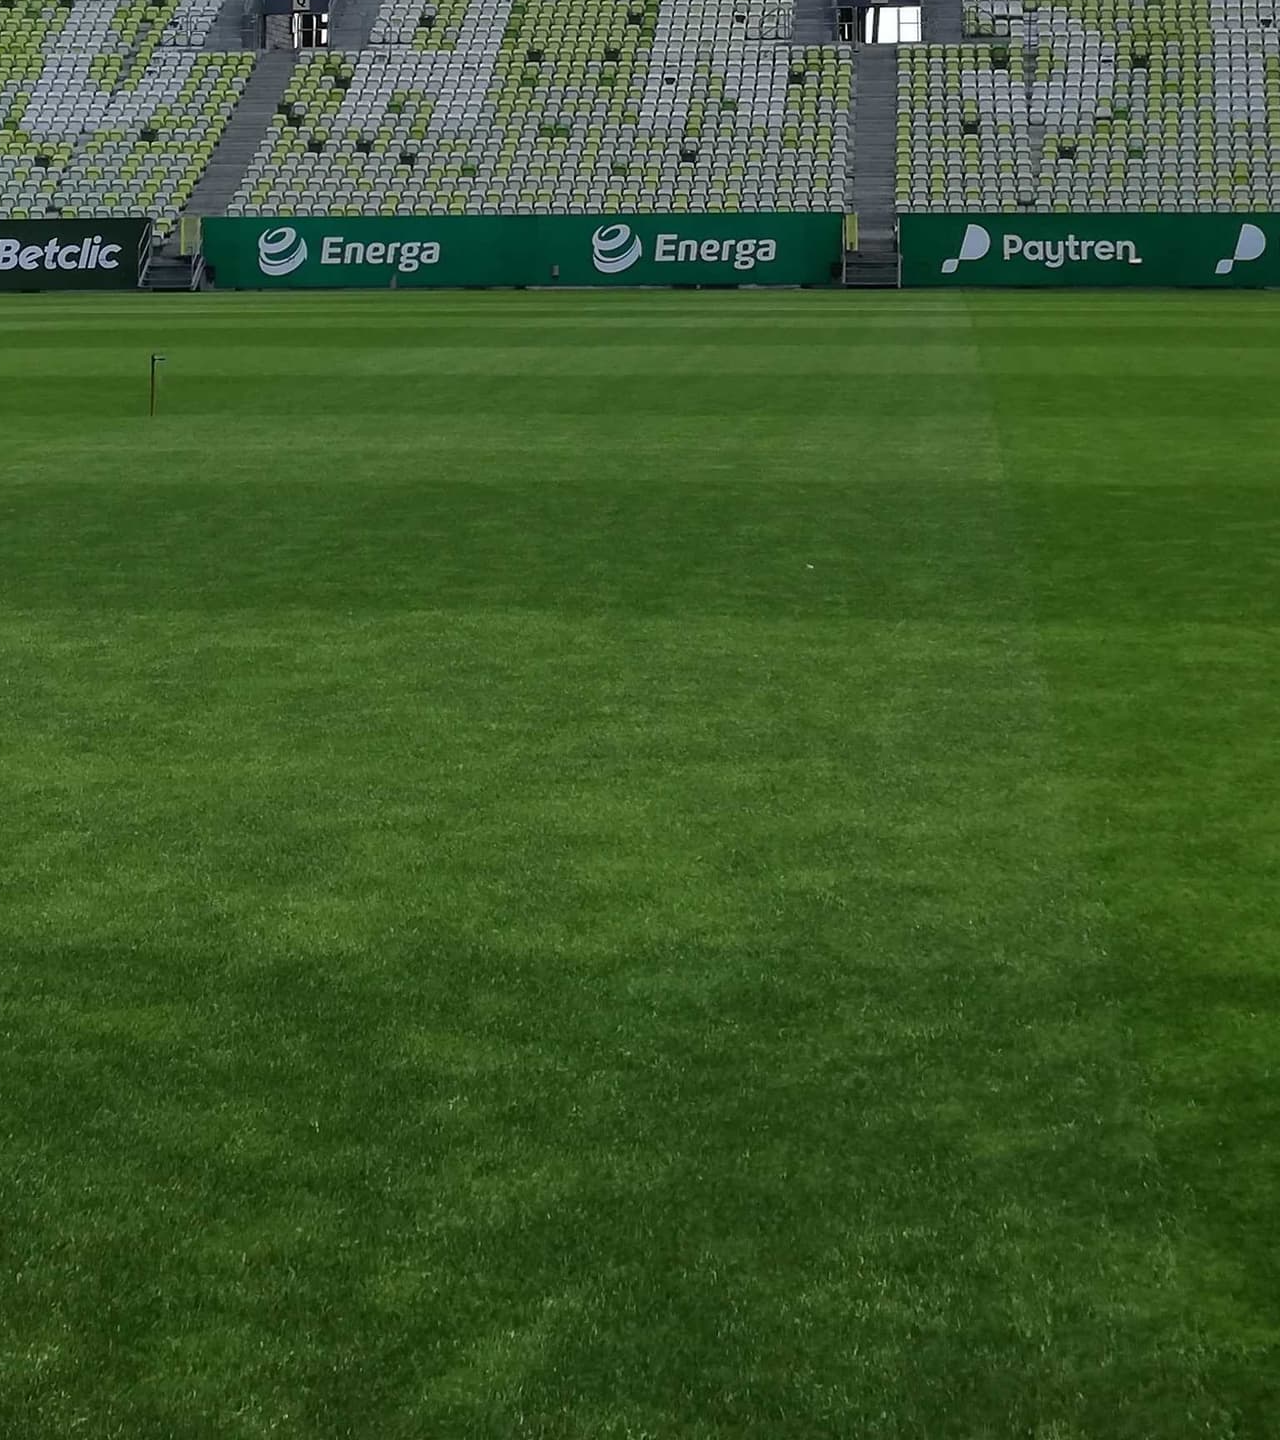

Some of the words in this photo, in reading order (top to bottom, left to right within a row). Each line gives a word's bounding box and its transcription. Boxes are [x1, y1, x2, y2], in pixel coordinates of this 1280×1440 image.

[320, 236, 441, 272] Energa
[654, 233, 777, 270] Energa
[1003, 234, 1136, 268] Paytren
